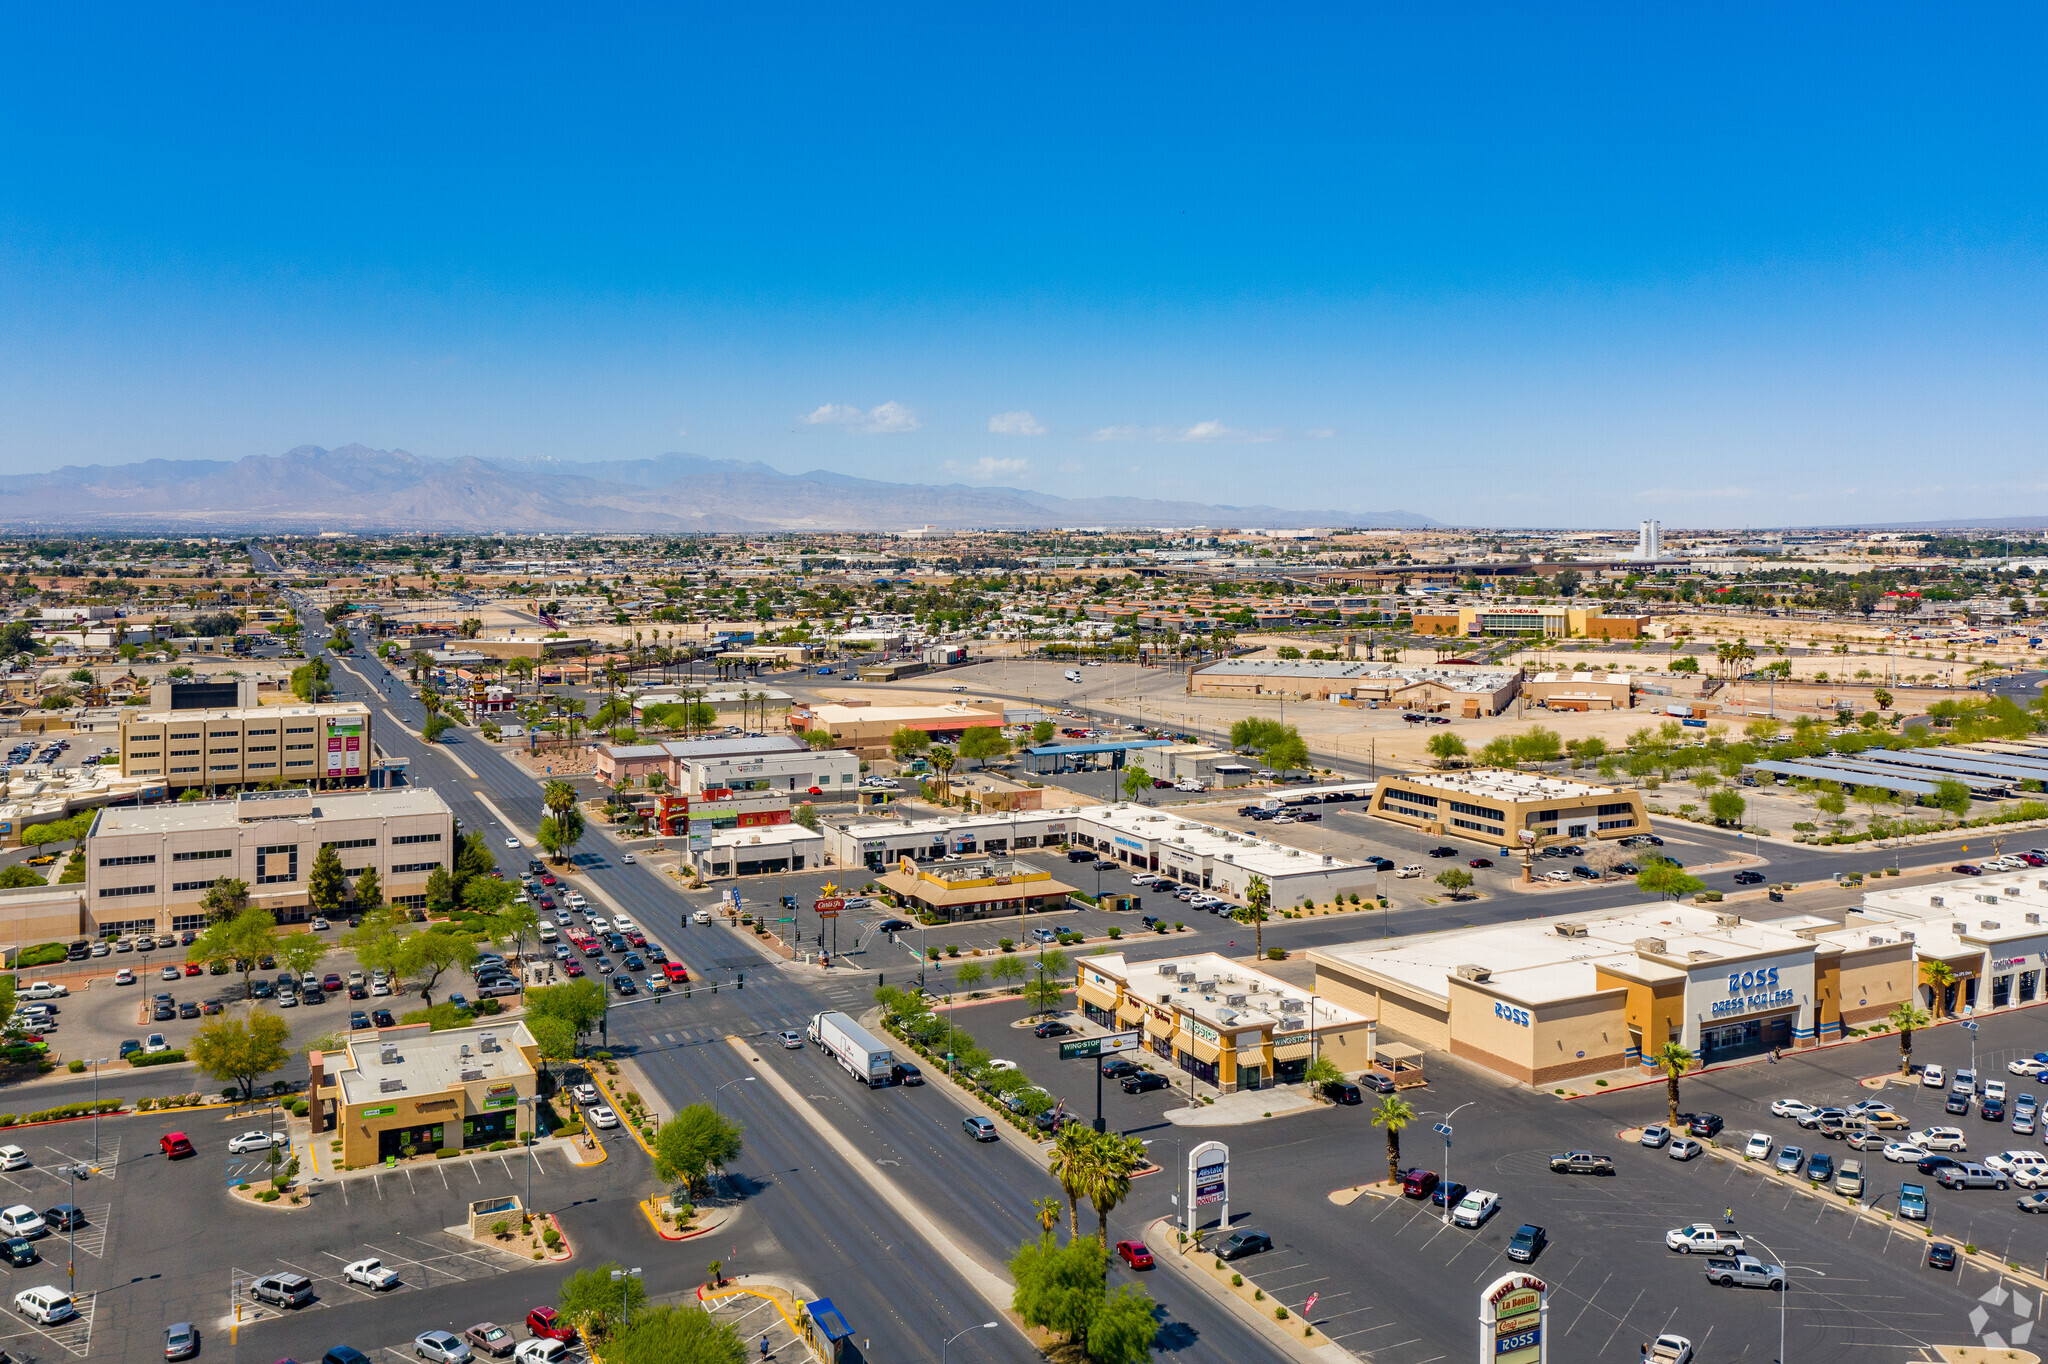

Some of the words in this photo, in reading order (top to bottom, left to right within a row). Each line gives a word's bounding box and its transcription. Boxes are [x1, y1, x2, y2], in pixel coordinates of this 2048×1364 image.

[1728, 966, 1778, 992] ROSS
[1712, 998, 1744, 1012] DRESS
[1747, 994, 1768, 1006] FOR
[1769, 988, 1793, 1002] LESS
[1495, 1002, 1529, 1026] ROSS
[1198, 1166, 1222, 1177] Allstate
[1522, 1277, 1546, 1292] PLAZA
[1502, 1302, 1510, 1310] La
[1512, 1295, 1535, 1307] Bonita
[1502, 1333, 1534, 1350] ROSS
